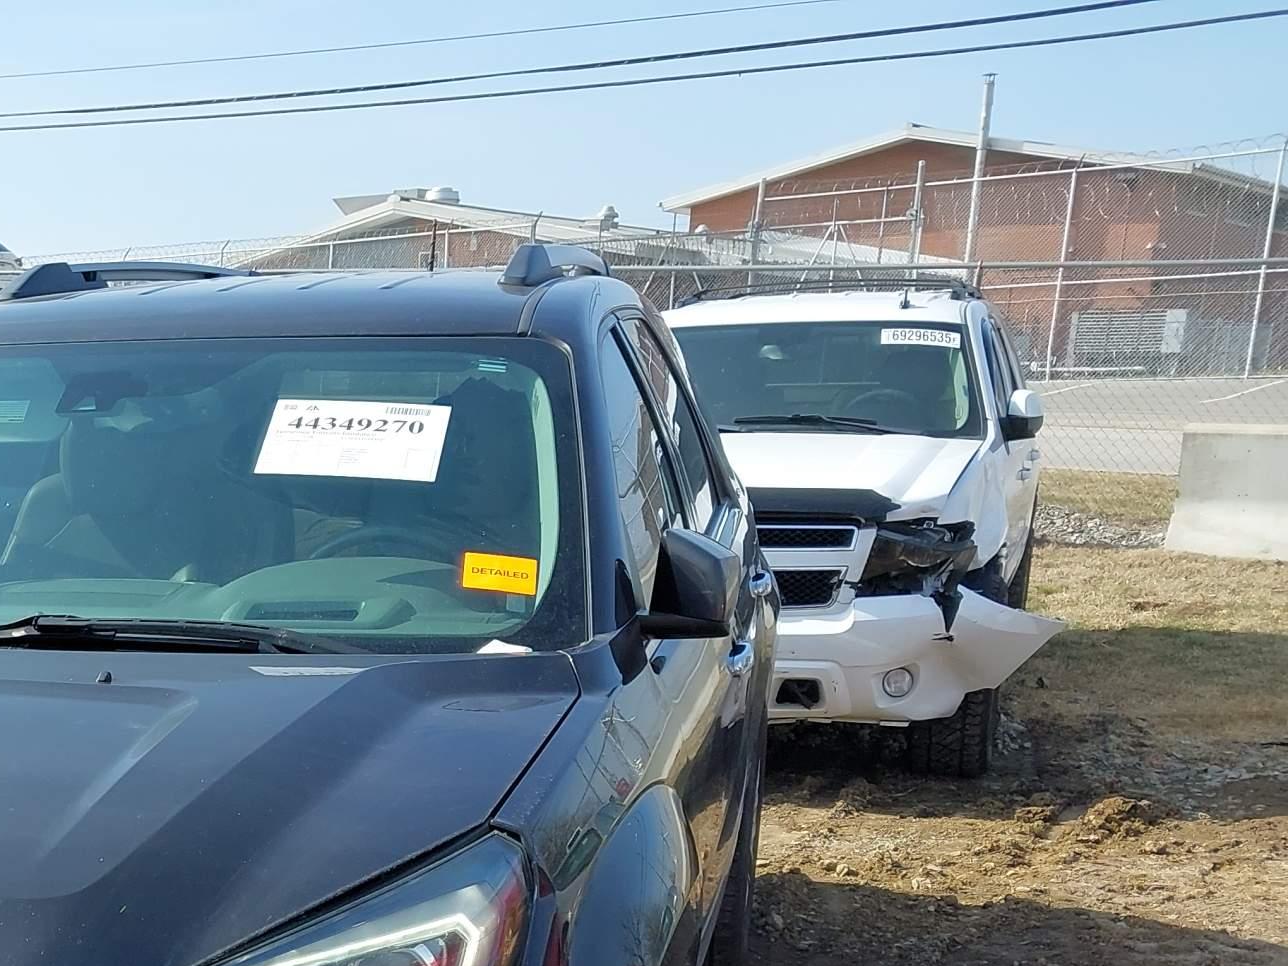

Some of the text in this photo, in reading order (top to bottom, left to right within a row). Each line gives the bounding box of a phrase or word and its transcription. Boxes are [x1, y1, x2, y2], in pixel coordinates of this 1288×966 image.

[892, 329, 952, 344] 69296535
[288, 416, 425, 435] 44349270
[471, 566, 530, 580] DETAILED
